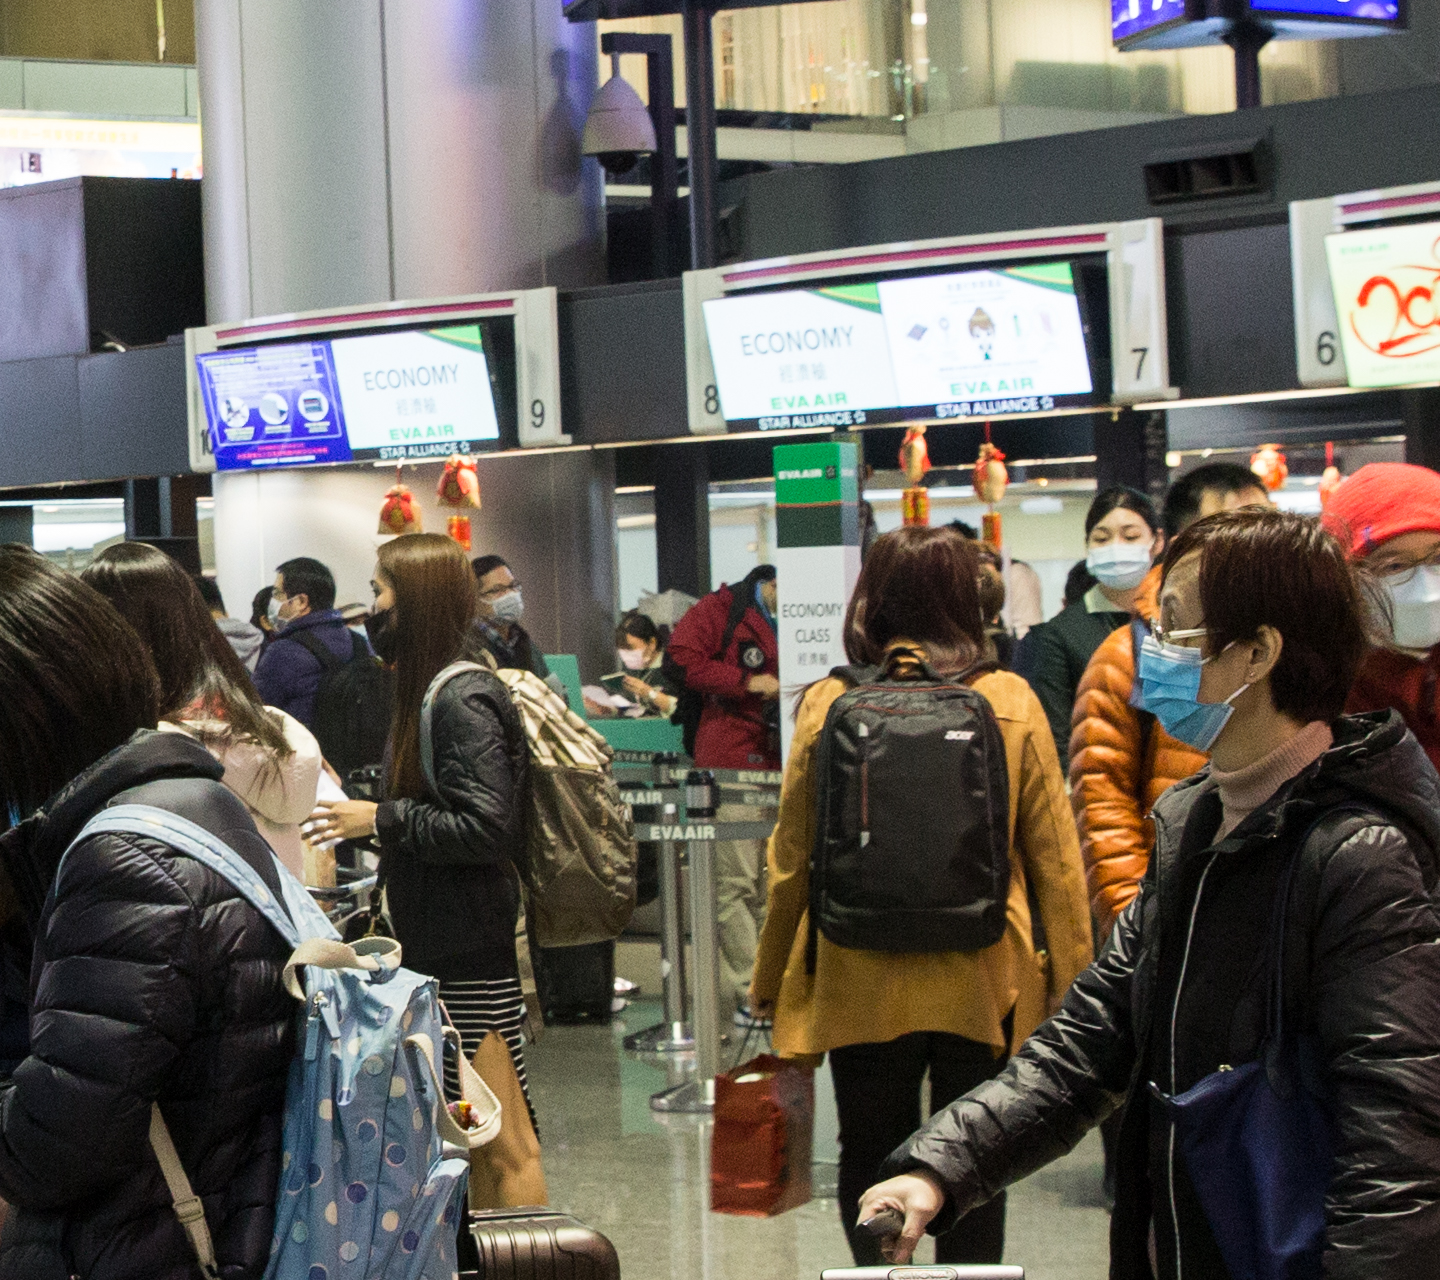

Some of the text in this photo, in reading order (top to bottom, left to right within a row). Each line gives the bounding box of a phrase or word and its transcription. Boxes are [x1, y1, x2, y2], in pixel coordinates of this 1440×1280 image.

[740, 324, 854, 357] ECONOMY
[1316, 331, 1336, 366] 6
[363, 363, 459, 392] ECONOMY
[1130, 347, 1149, 381] 7
[531, 399, 546, 428] 9
[703, 384, 720, 414] 8
[935, 397, 1040, 418] STAR ALLIANCE
[758, 411, 853, 431] STAR ALLIANCE
[379, 441, 459, 459] STAR ALLIANCE
[782, 603, 844, 619] ECONOMY
[794, 628, 831, 644] CLASS
